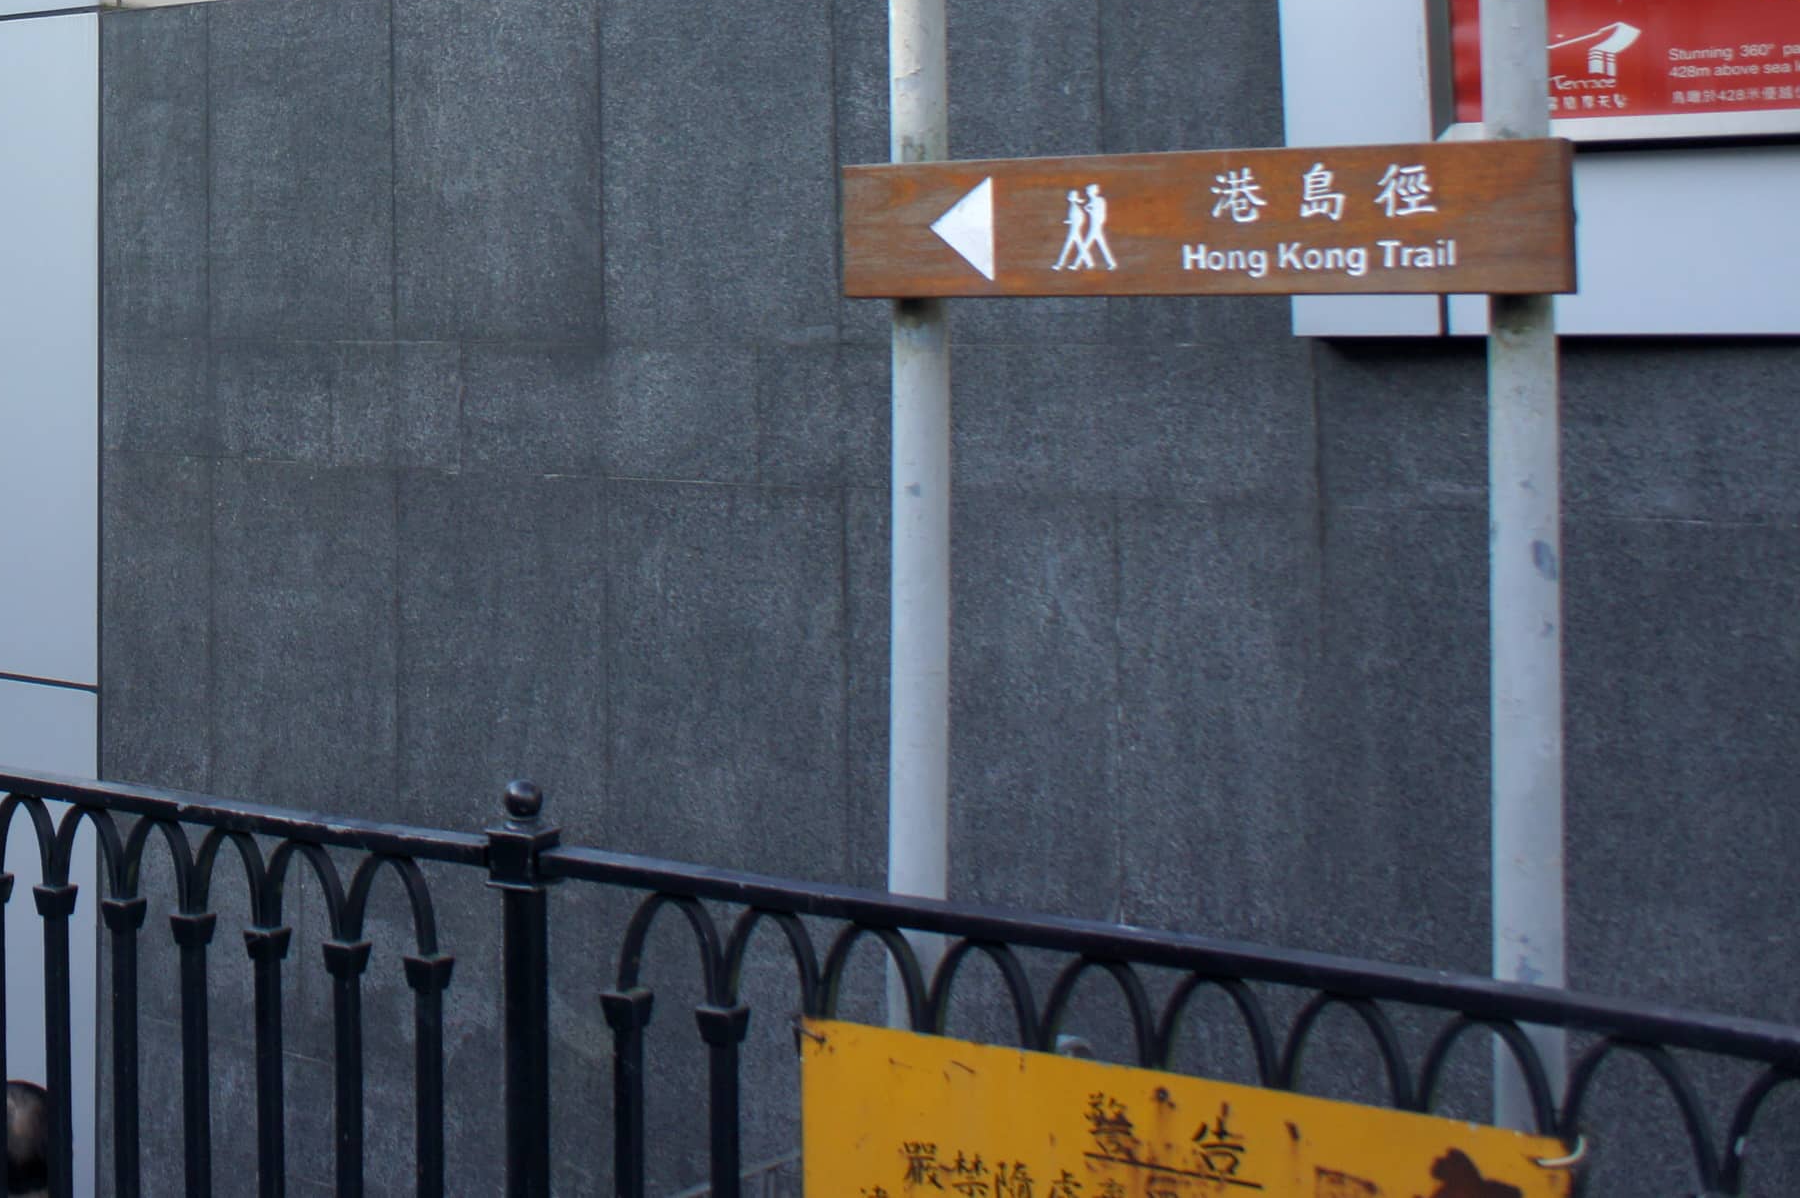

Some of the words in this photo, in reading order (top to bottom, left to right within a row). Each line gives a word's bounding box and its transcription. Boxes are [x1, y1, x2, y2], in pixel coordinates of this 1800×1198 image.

[1668, 47, 1733, 62] Stunning
[1668, 66, 1710, 79] 428m
[1714, 61, 1759, 76] above
[1763, 62, 1791, 74] sea
[1210, 162, 1438, 223] 港島徑
[1182, 243, 1268, 279] Hong
[1278, 241, 1368, 277] Kong
[1376, 240, 1457, 269] Trail
[1084, 1092, 1246, 1176] 警告
